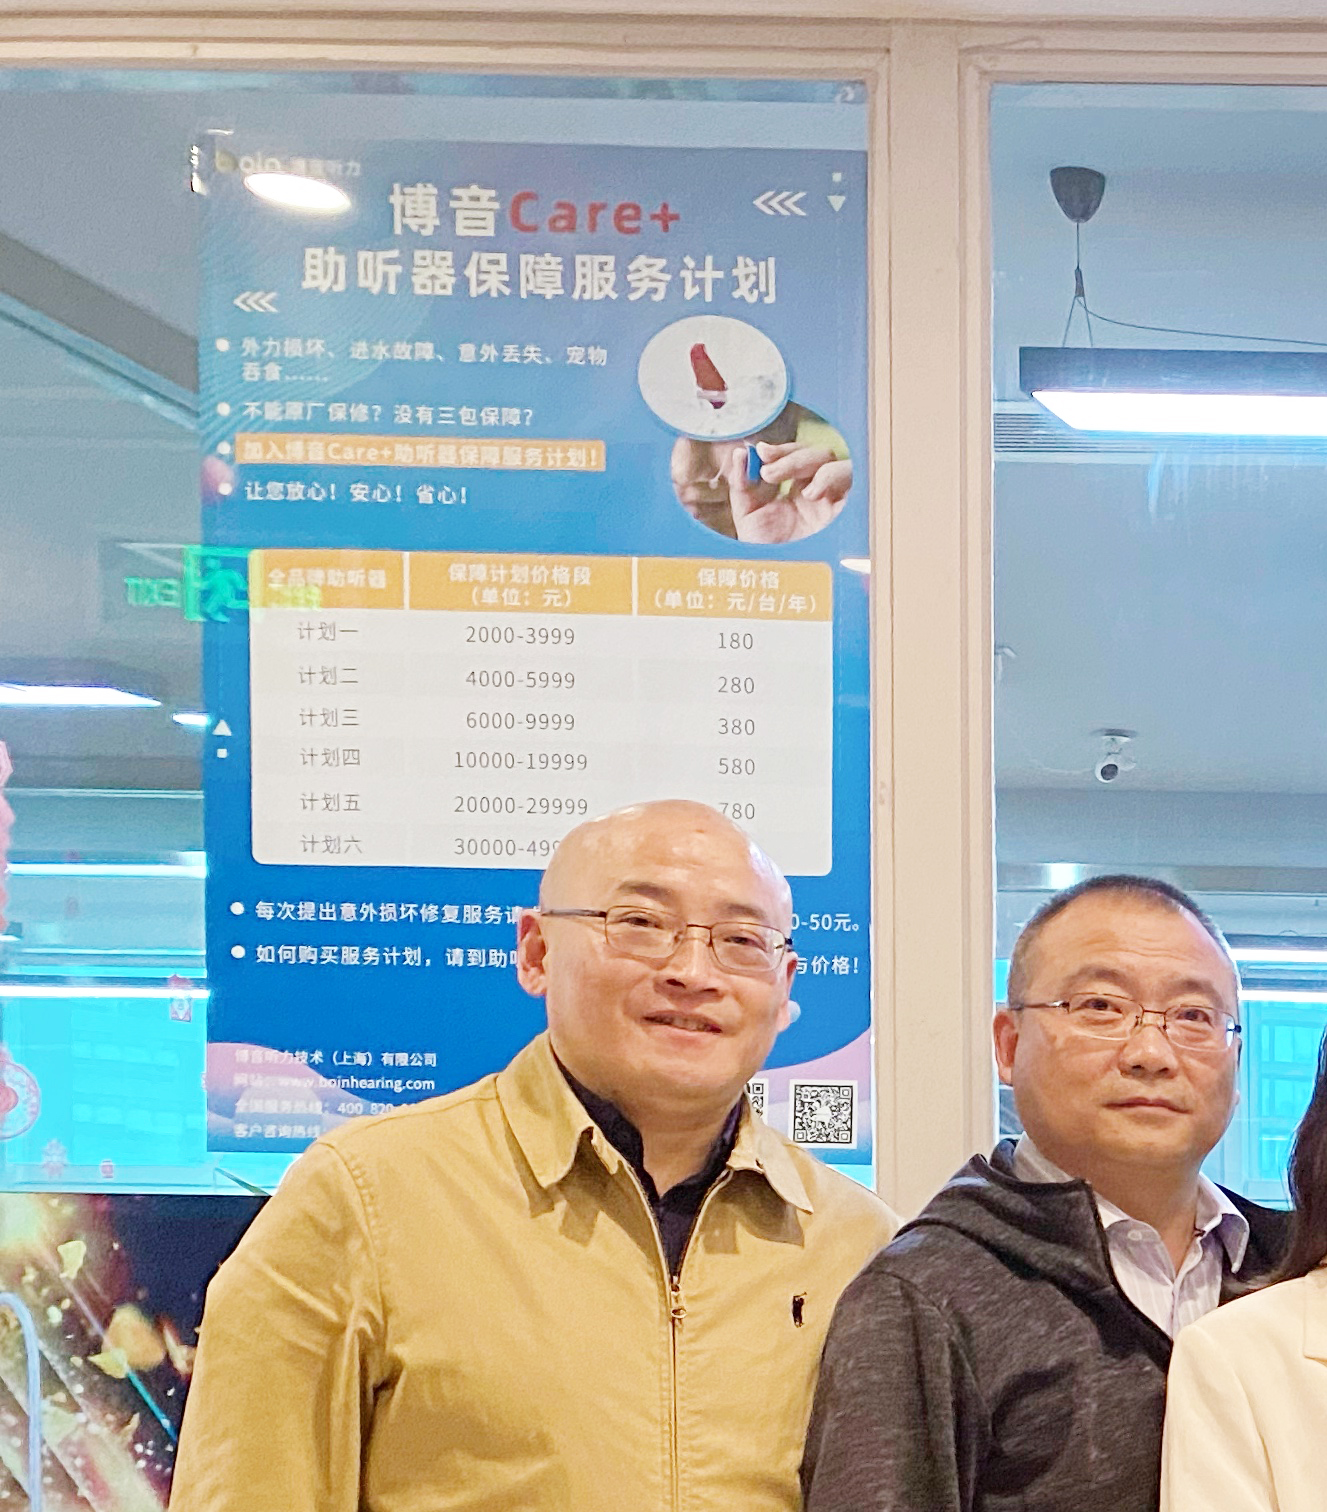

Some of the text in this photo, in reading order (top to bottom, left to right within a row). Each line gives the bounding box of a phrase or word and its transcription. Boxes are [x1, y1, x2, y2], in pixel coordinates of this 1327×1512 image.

[389, 183, 680, 238] 博音Care+
[302, 247, 776, 304] 助听器保障服务计划
[449, 563, 591, 587] 保障计划价格段
[698, 567, 780, 590] 保障价格
[471, 588, 573, 608] （单位：元）
[298, 621, 359, 642] 计划一
[466, 626, 575, 646] 2000-3999
[718, 632, 754, 650] 180
[299, 666, 359, 686] 计划二
[466, 670, 575, 690] 4000-5999
[718, 676, 755, 694] 280
[300, 707, 360, 728] 计划三
[466, 712, 575, 732] 6000-9999
[718, 718, 755, 736] 380
[300, 748, 361, 768] 计划四
[454, 750, 588, 771] 10000-19999
[718, 758, 755, 776] 580
[300, 793, 361, 813] 计划五
[454, 796, 588, 815] 20000-29999
[718, 803, 755, 820] 780
[300, 834, 362, 854] 计划六
[255, 901, 541, 924] 每次提出意外损坏修复服务请
[337, 1102, 363, 1115] 400
